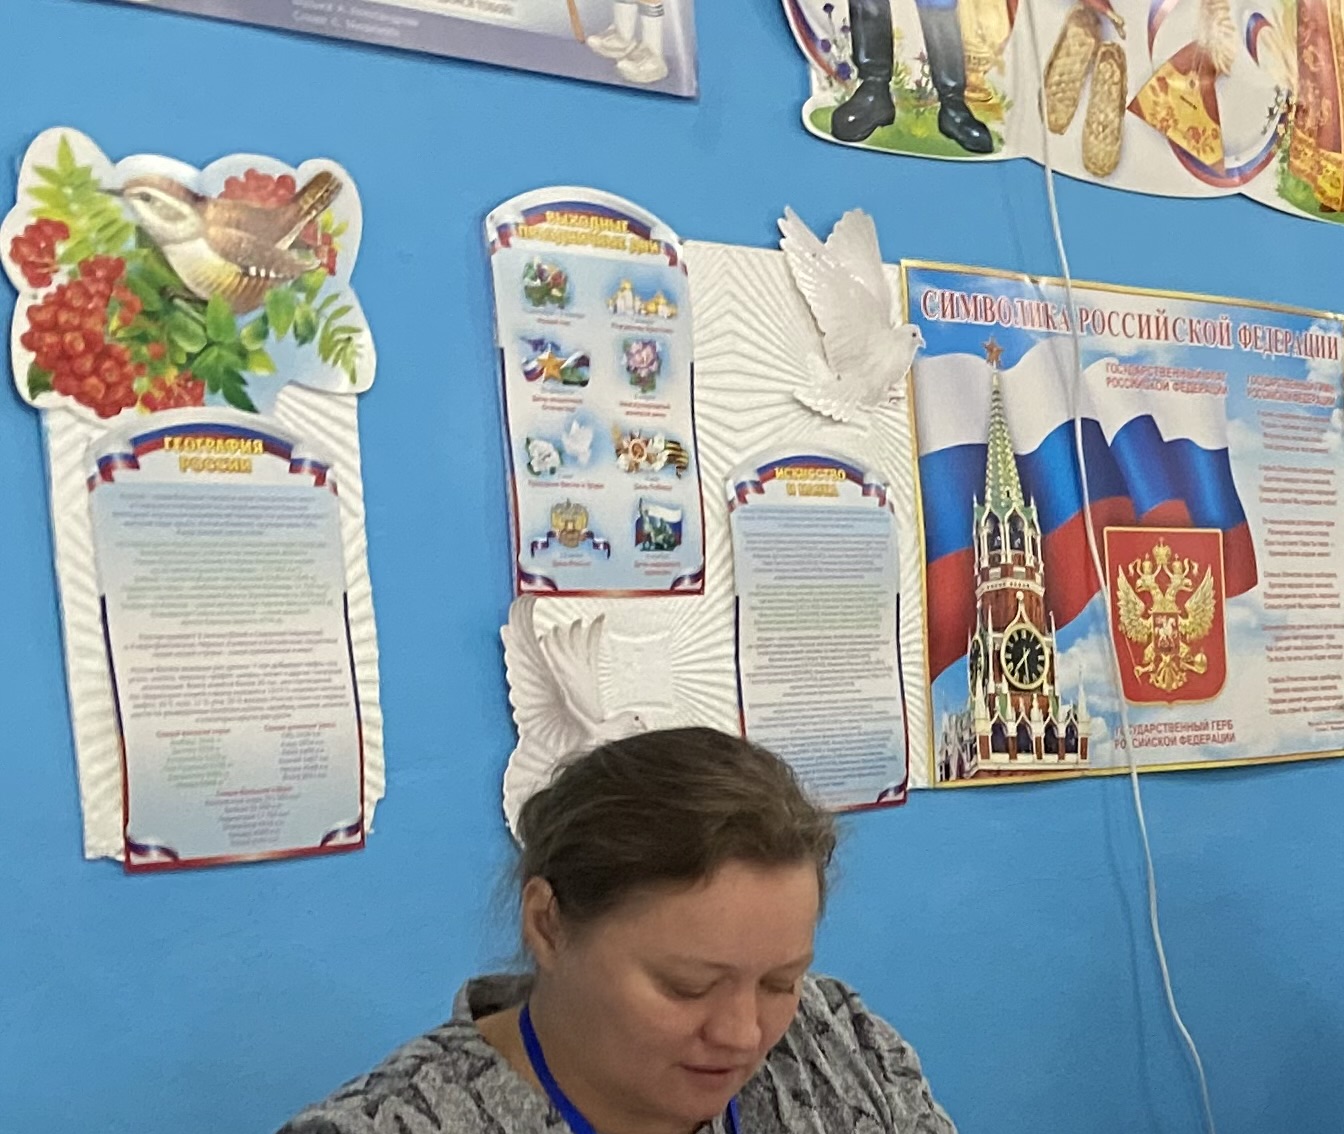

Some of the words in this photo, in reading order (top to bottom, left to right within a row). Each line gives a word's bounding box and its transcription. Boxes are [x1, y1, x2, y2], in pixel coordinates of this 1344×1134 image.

[921, 289, 1070, 333] СИМВОЛИКА
[1079, 308, 1231, 347] РОССИЙСКОЙ
[1239, 327, 1340, 361] ФЕДЕРАЦИИ
[164, 436, 264, 455] ГЕОГРАФИЯ
[179, 455, 253, 474] РОССИИ
[1114, 721, 1209, 737] ГУДАРСТВЕННЫЙ
[1211, 719, 1234, 731] ГЕРБ
[1114, 734, 1177, 749] РОСИЙСКОЙ
[1180, 732, 1236, 746] ФЕДЕРАЦИИ
